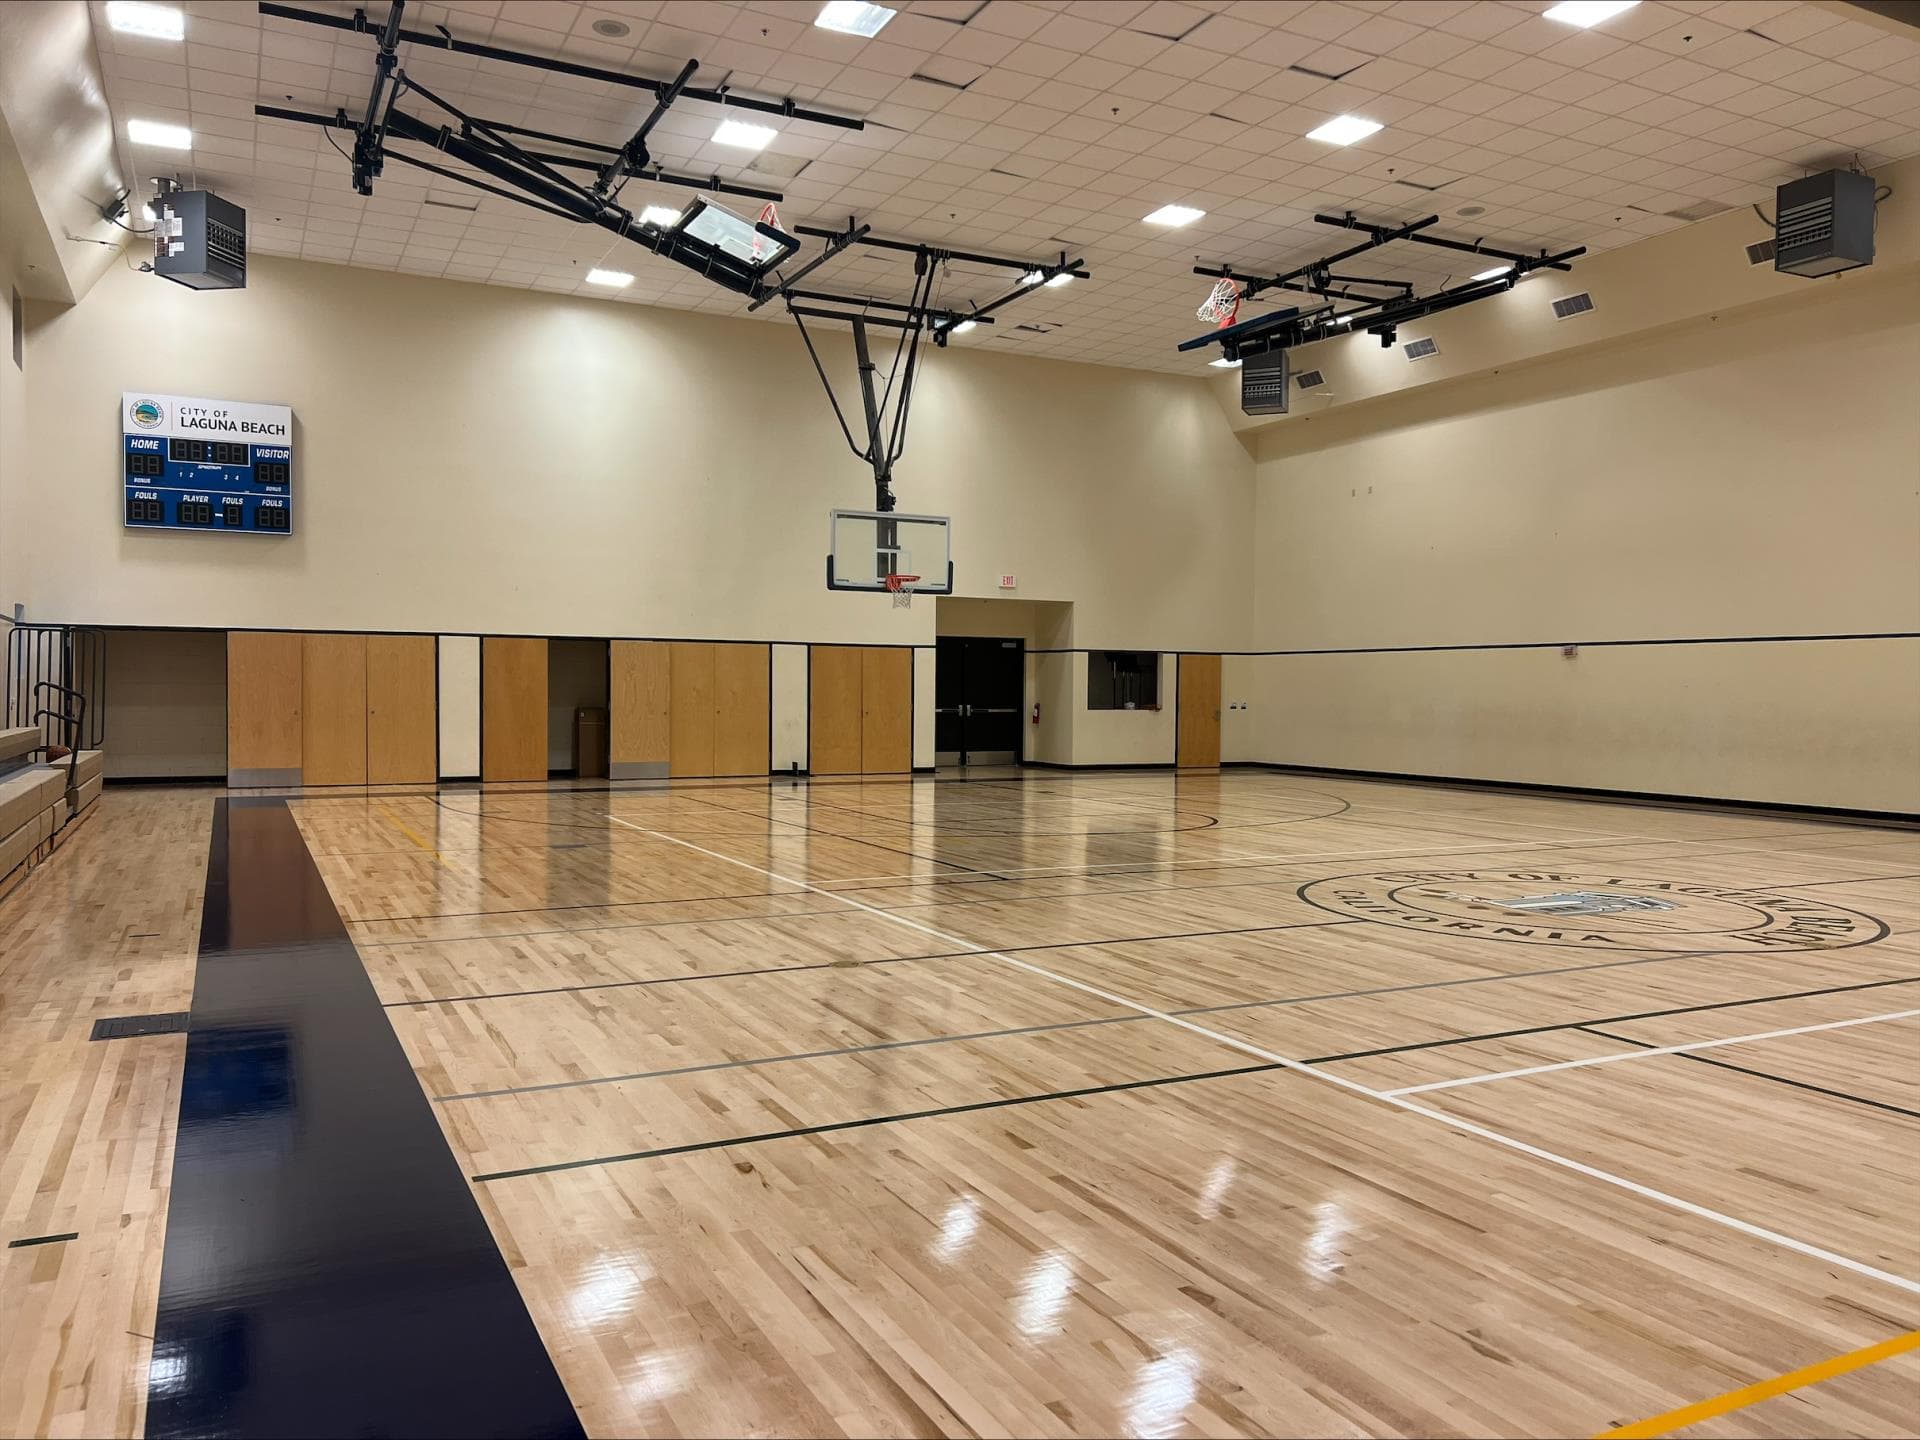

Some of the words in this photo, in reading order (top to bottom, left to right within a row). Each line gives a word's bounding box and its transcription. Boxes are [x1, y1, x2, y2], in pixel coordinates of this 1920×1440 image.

[180, 407, 208, 416] CITY
[213, 410, 229, 418] OF
[180, 416, 238, 432] LAGUNA
[241, 421, 286, 436] BEACH
[131, 439, 160, 450] HOME
[256, 448, 290, 460] VISITOR
[134, 492, 158, 500] FOULS
[182, 494, 209, 503] PLAYER
[221, 496, 244, 505] FOULS
[261, 498, 284, 507] FOULS
[1002, 575, 1014, 586] EXIT
[1374, 872, 1481, 884] CITY
[1508, 873, 1581, 882] OF
[1607, 878, 1829, 913] LAGUNA
[1728, 915, 1856, 946] BEACH
[1333, 890, 1617, 943] CALIFORNIA
